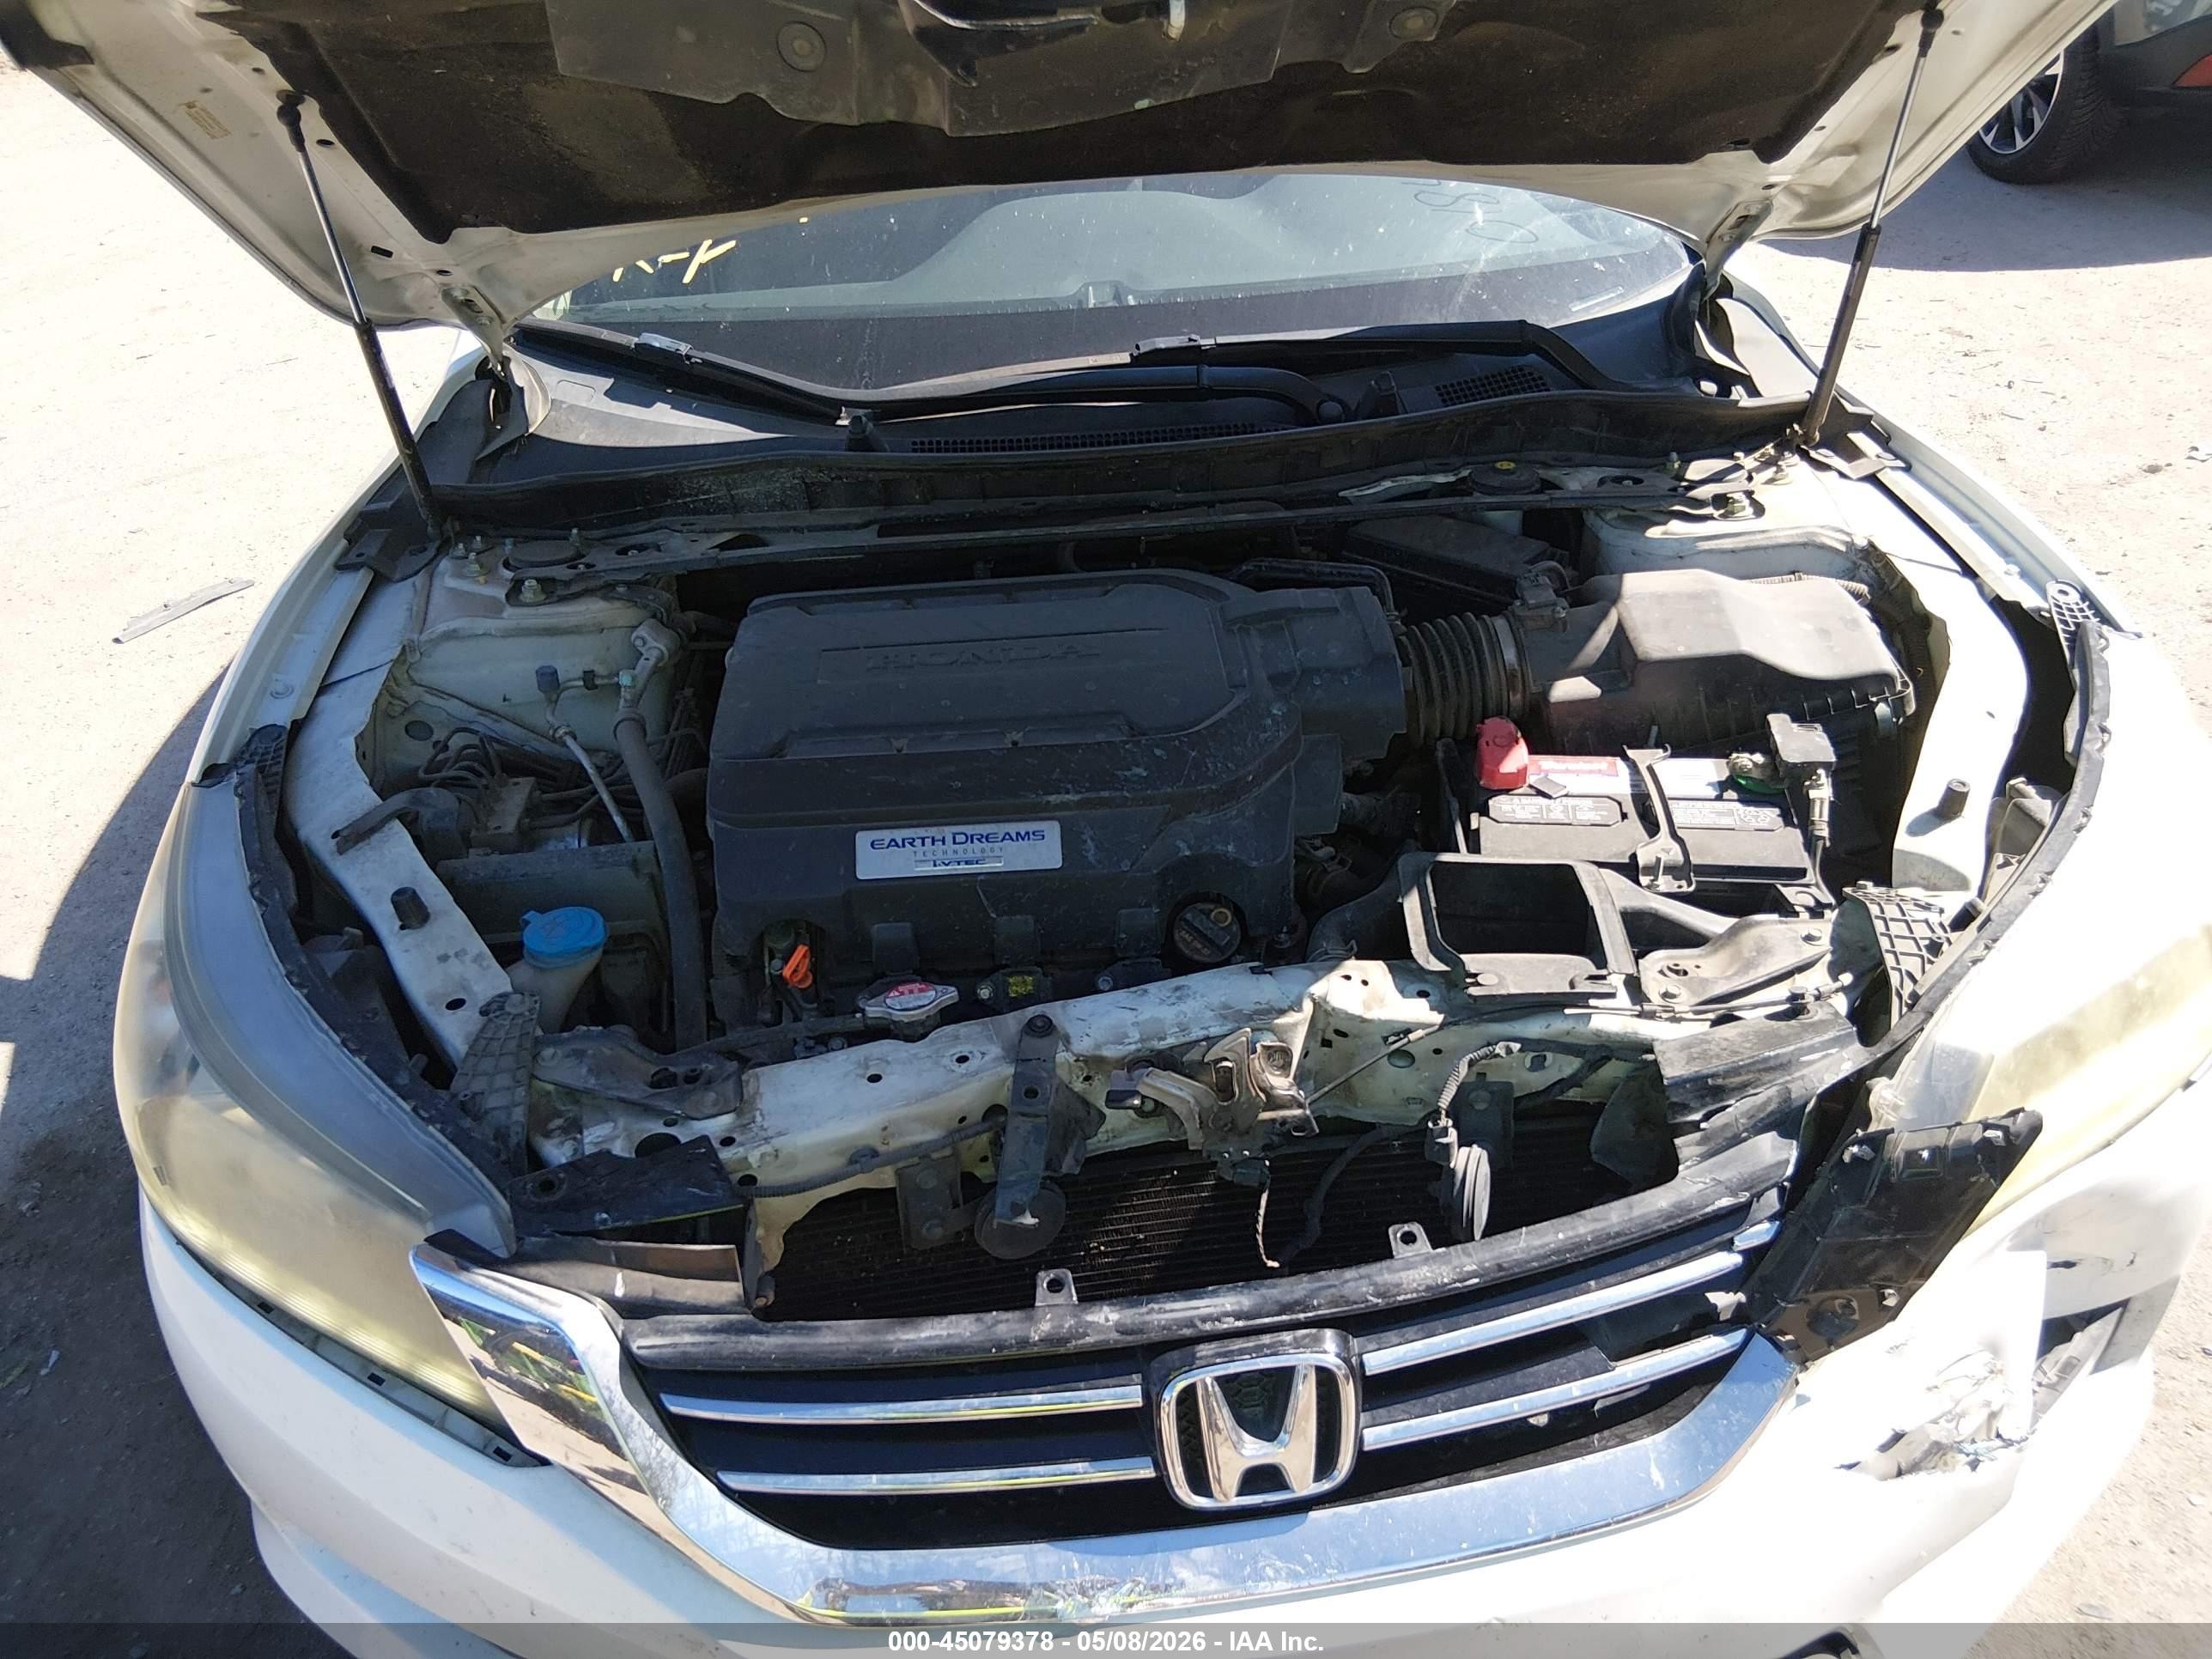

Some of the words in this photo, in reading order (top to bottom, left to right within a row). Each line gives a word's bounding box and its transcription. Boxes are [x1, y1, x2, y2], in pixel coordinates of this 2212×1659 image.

[870, 835, 945, 850] EARTH
[952, 830, 1045, 845] DREAMS
[914, 847, 1004, 857] TECHNOLOGY
